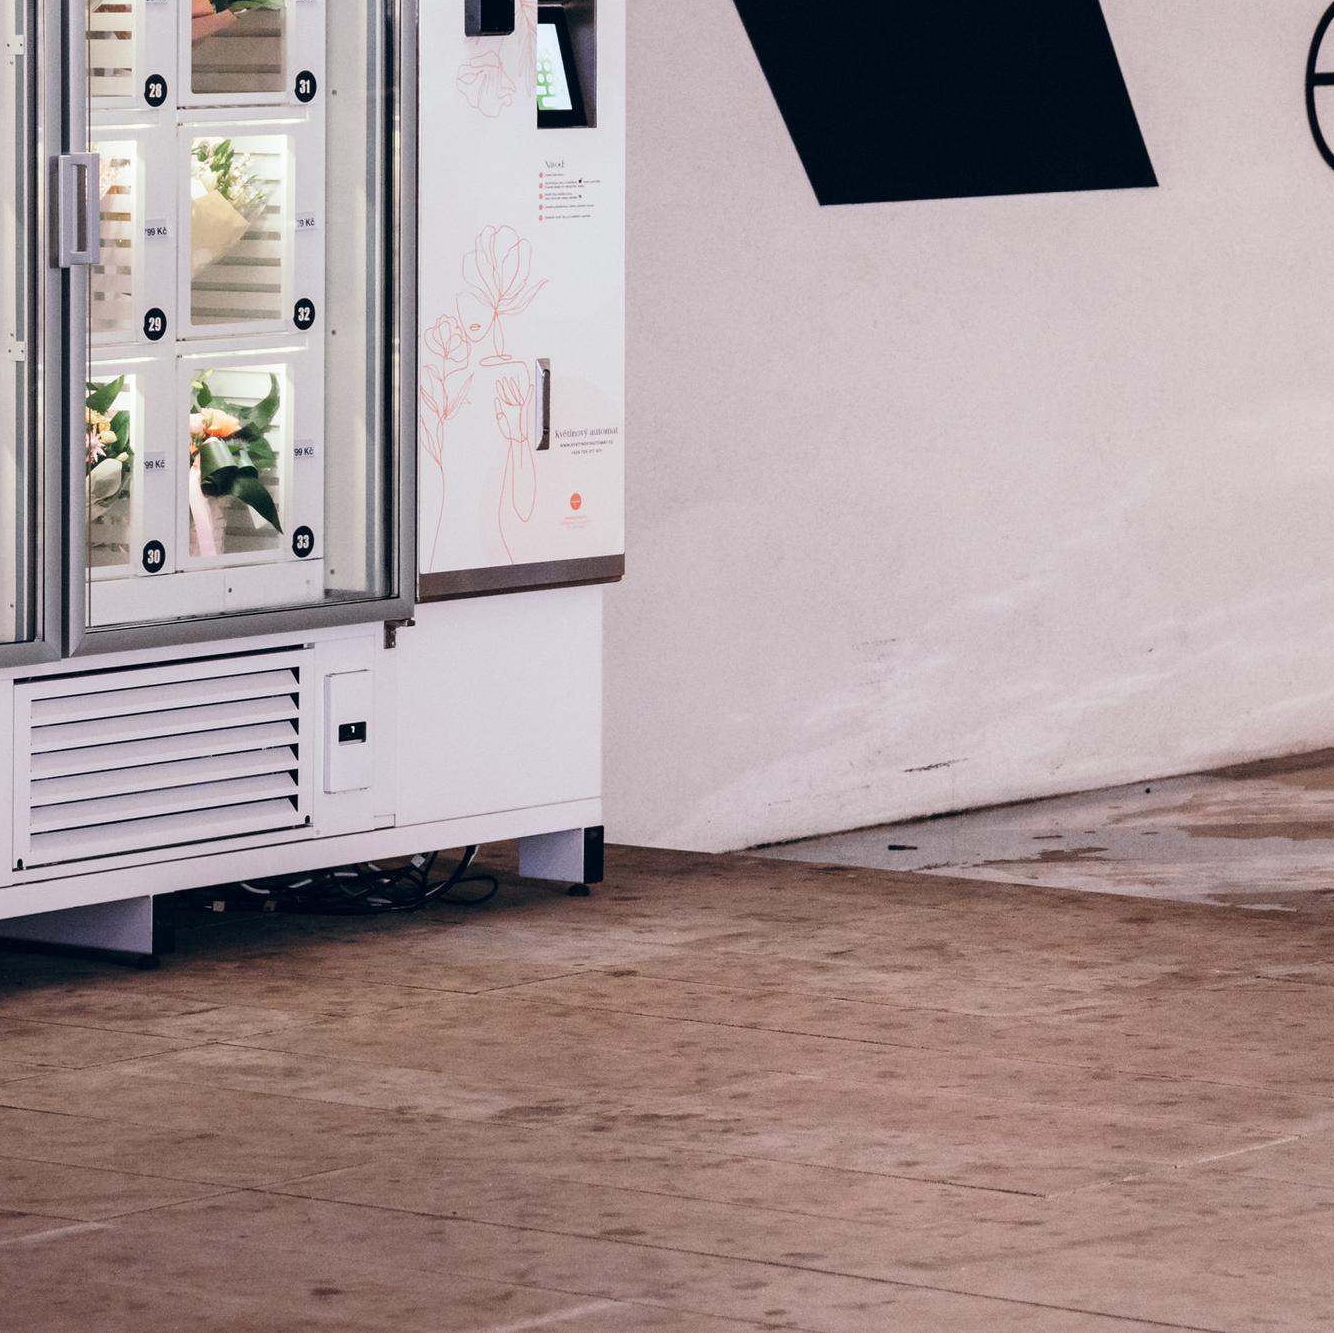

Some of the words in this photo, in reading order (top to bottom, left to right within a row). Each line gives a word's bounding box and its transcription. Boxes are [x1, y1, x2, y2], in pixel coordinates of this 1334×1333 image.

[149, 83, 162, 98] 28
[299, 79, 310, 94] 31
[156, 226, 168, 236] Kč
[298, 306, 311, 321] 32
[148, 317, 162, 332] 29
[303, 445, 314, 456] Kč
[143, 460, 154, 469] 99
[155, 459, 166, 468] Kč
[297, 534, 310, 549] 33
[147, 549, 161, 564] 30
